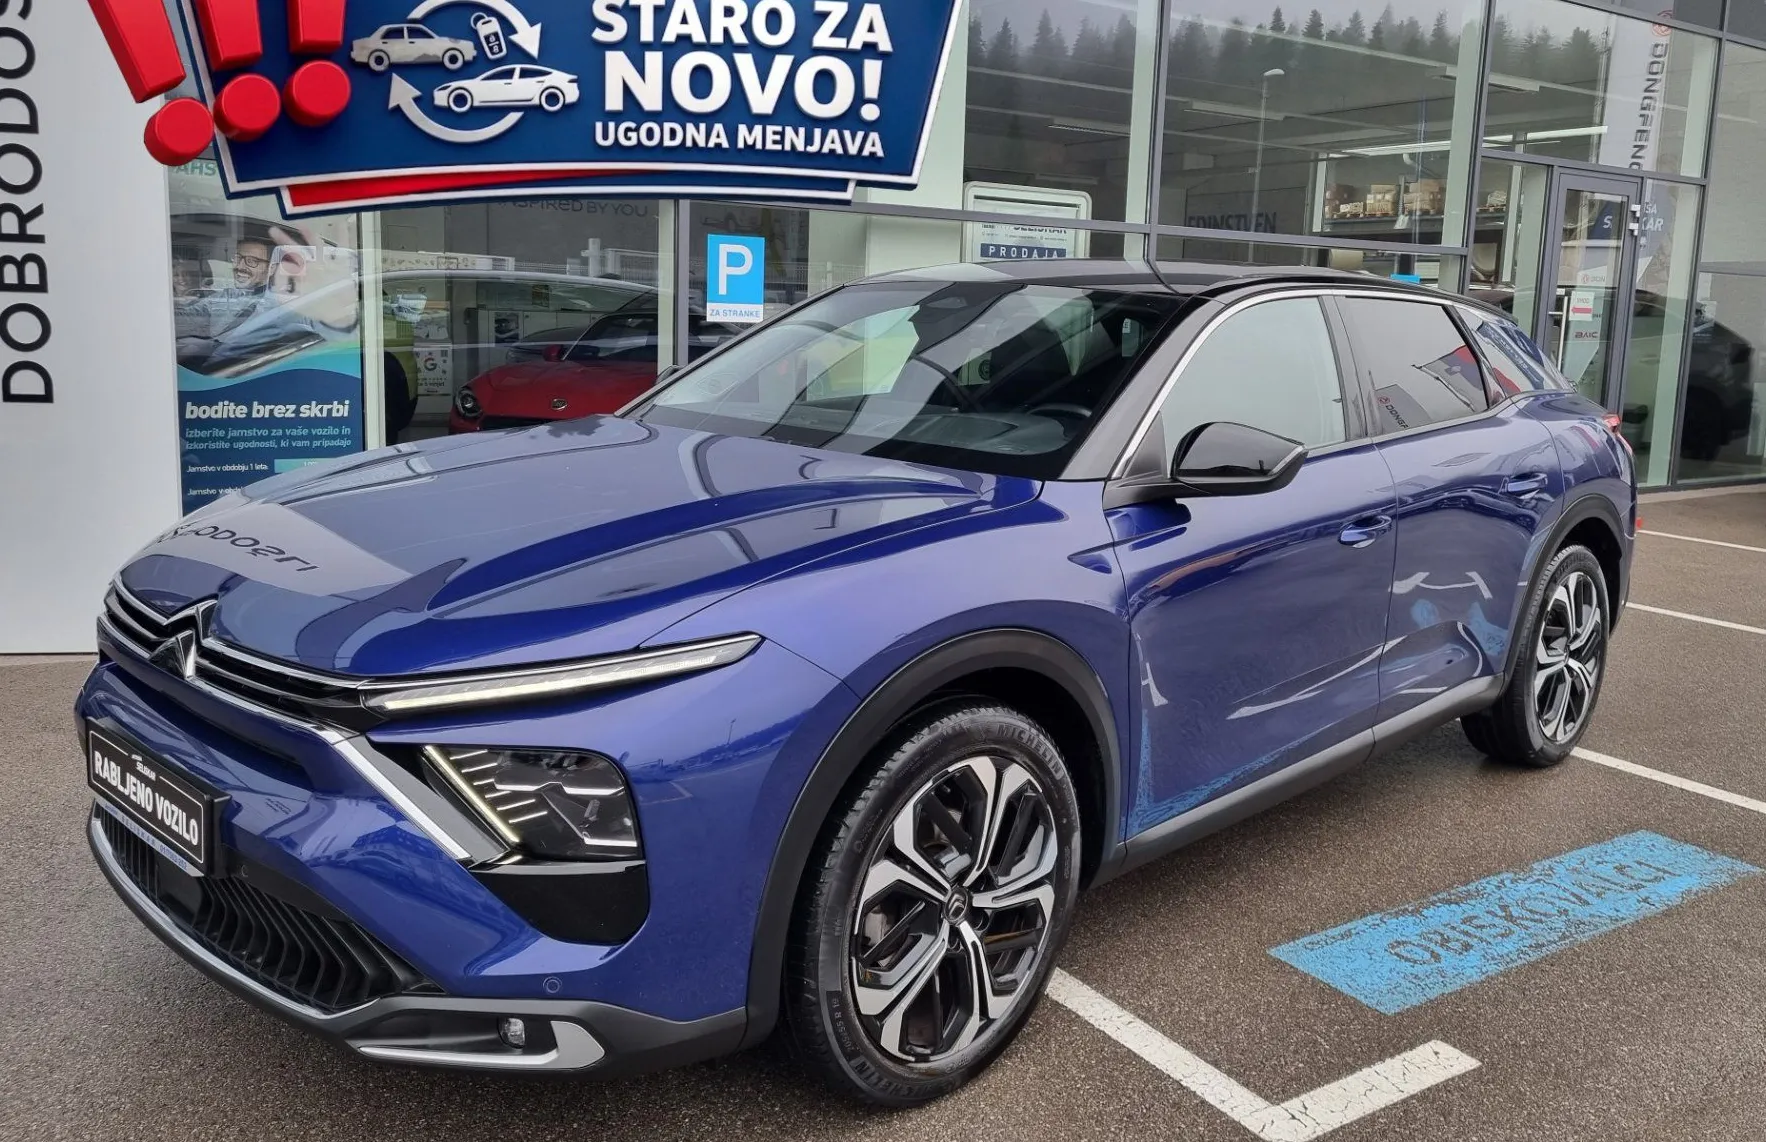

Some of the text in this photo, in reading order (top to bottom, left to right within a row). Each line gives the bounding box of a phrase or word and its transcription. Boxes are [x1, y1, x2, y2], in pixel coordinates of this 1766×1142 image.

[587, 202, 608, 214] BY
[611, 204, 648, 217] YOU
[988, 245, 1058, 259] PRODAJA
[718, 244, 754, 296] P
[710, 309, 760, 318] ZA STRANKE
[185, 400, 350, 419] bodite brez skrbi
[185, 426, 351, 439] izberite jamstvo za vaše vozilo in
[186, 440, 230, 449] izkoristite
[233, 439, 278, 449] ugodnosti,
[280, 439, 289, 447] ki
[312, 439, 352, 448] pripadajo
[222, 464, 249, 473] obdobju
[187, 487, 217, 495] Jamstvo
[997, 723, 1064, 779] MICHELIN
[94, 750, 198, 845] RABLJENO VOZILO
